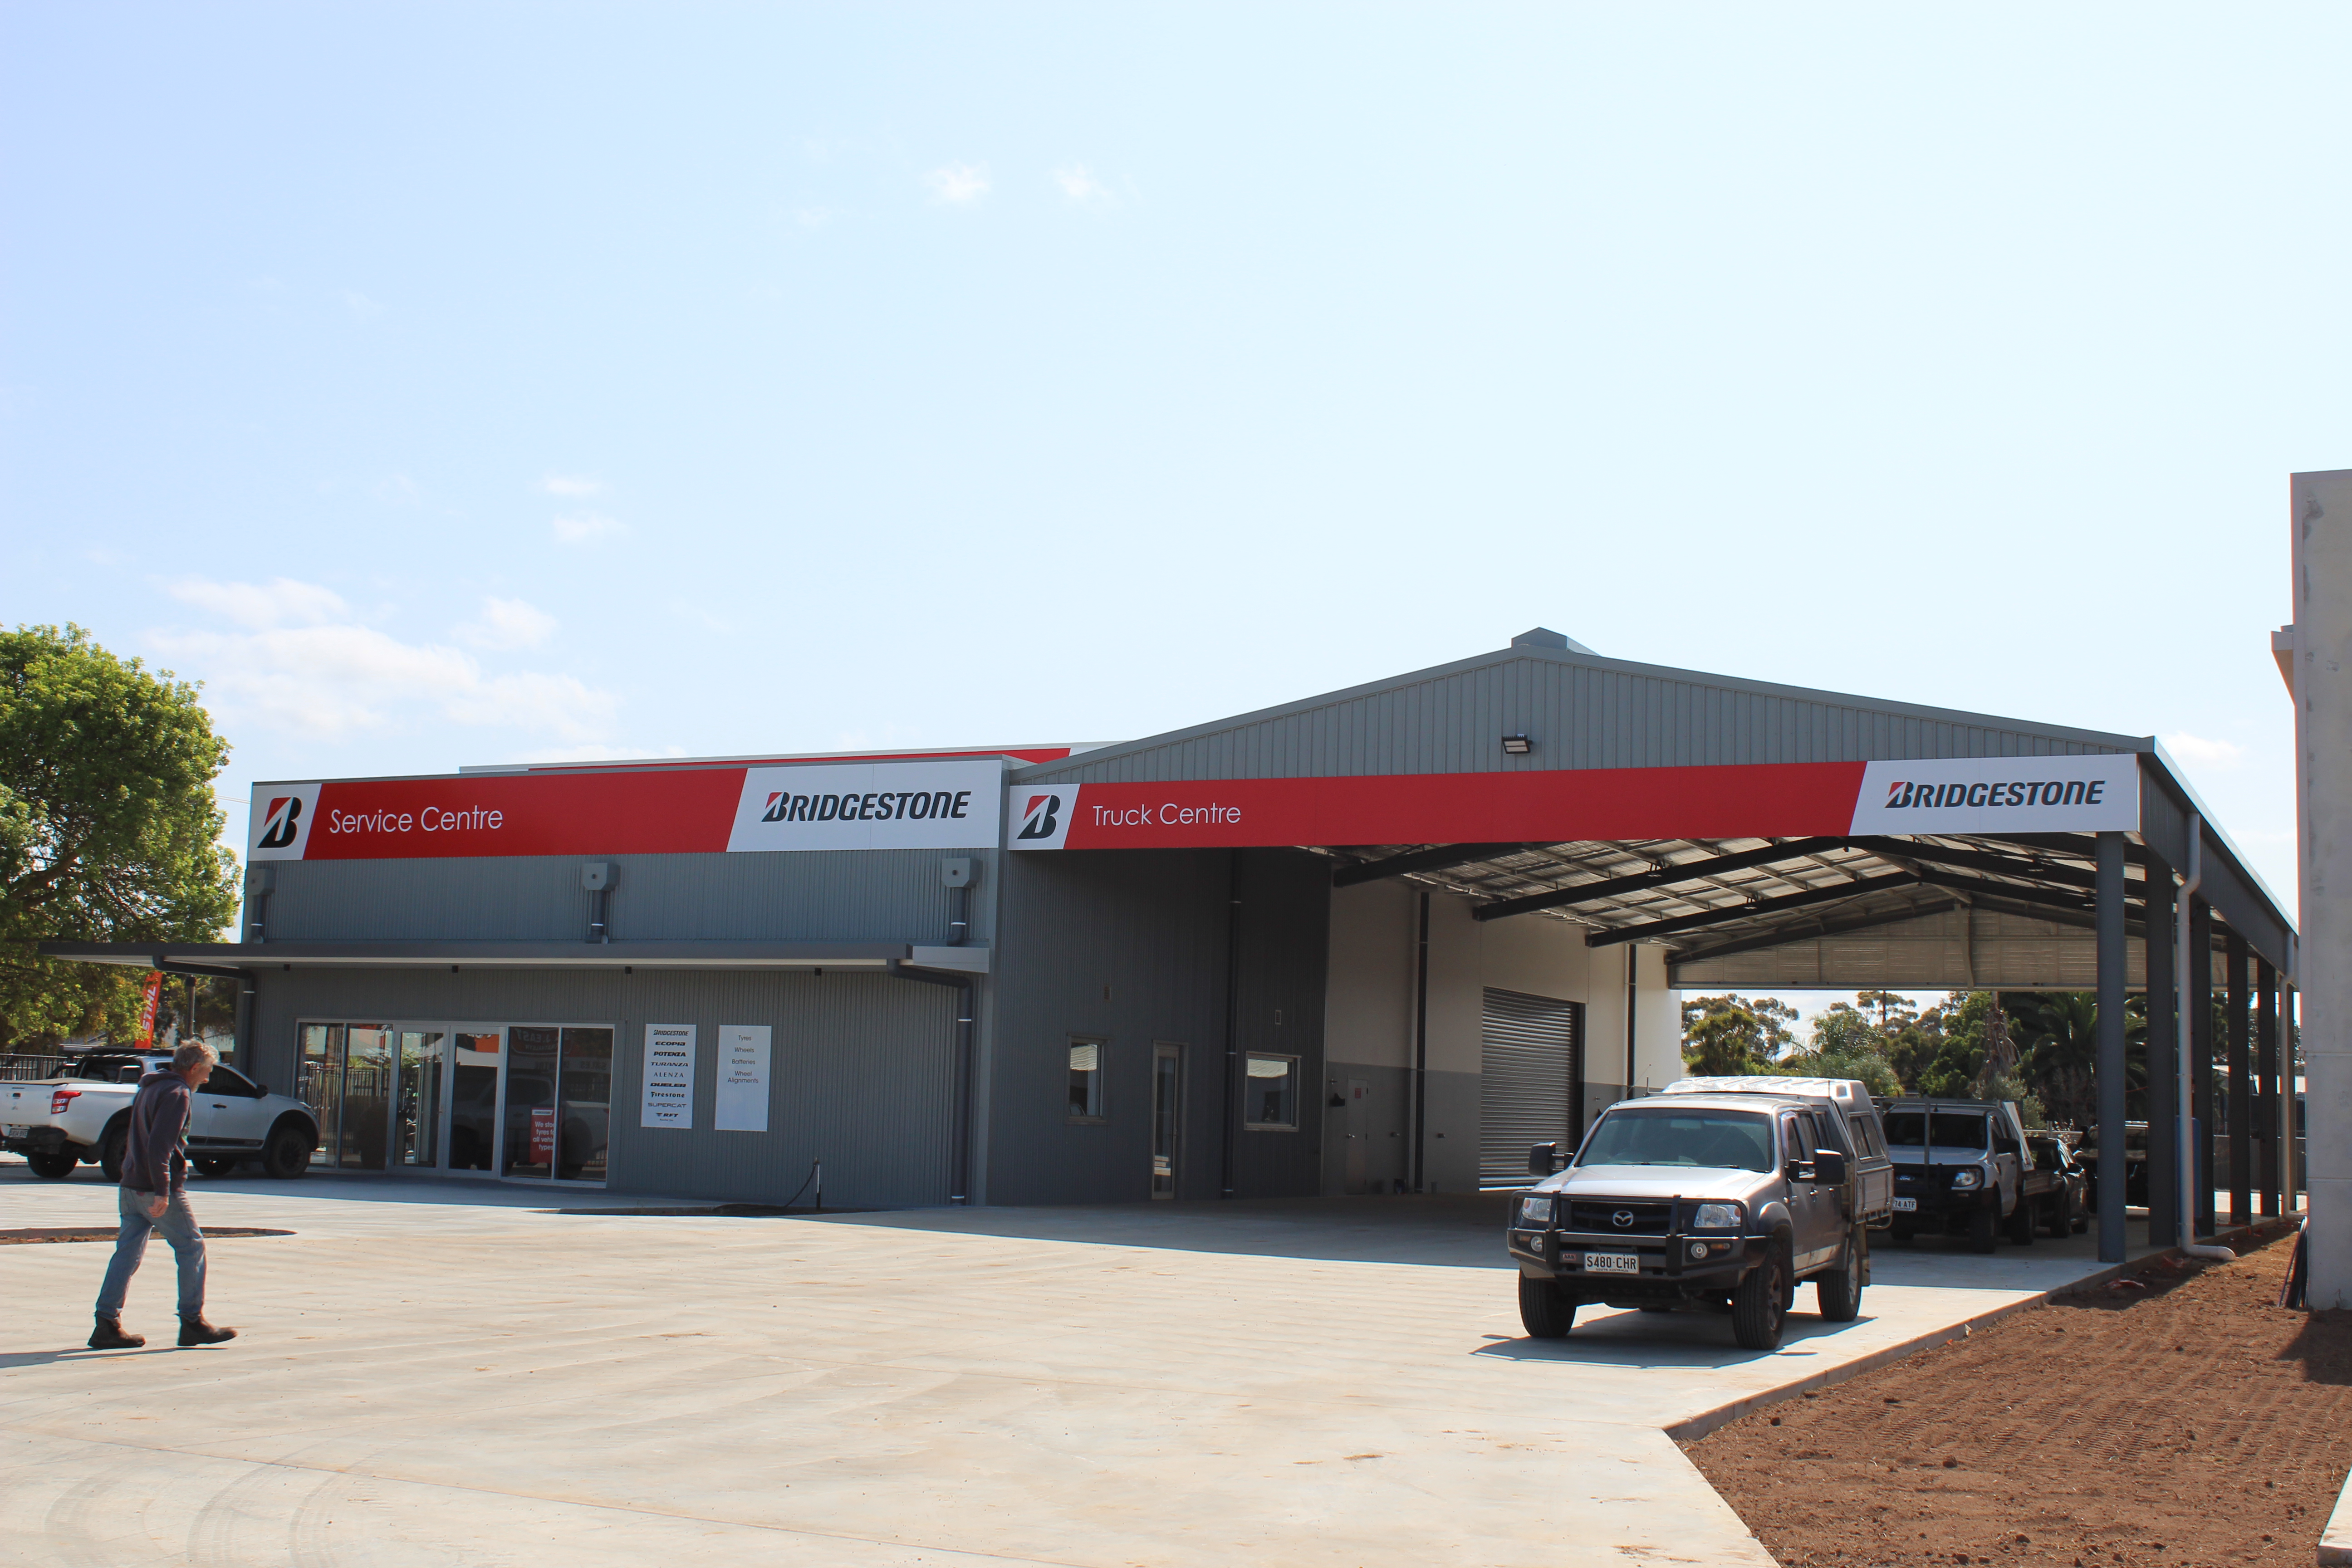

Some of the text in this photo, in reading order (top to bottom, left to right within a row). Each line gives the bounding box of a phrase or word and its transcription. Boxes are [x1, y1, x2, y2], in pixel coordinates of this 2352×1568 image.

[761, 791, 971, 822] BRIDGESTONE
[1885, 780, 2105, 808] BRIDGESTONE
[329, 805, 503, 833] Service Centre
[1093, 802, 1241, 826] Truck Centre
[142, 986, 156, 1031] STIHL
